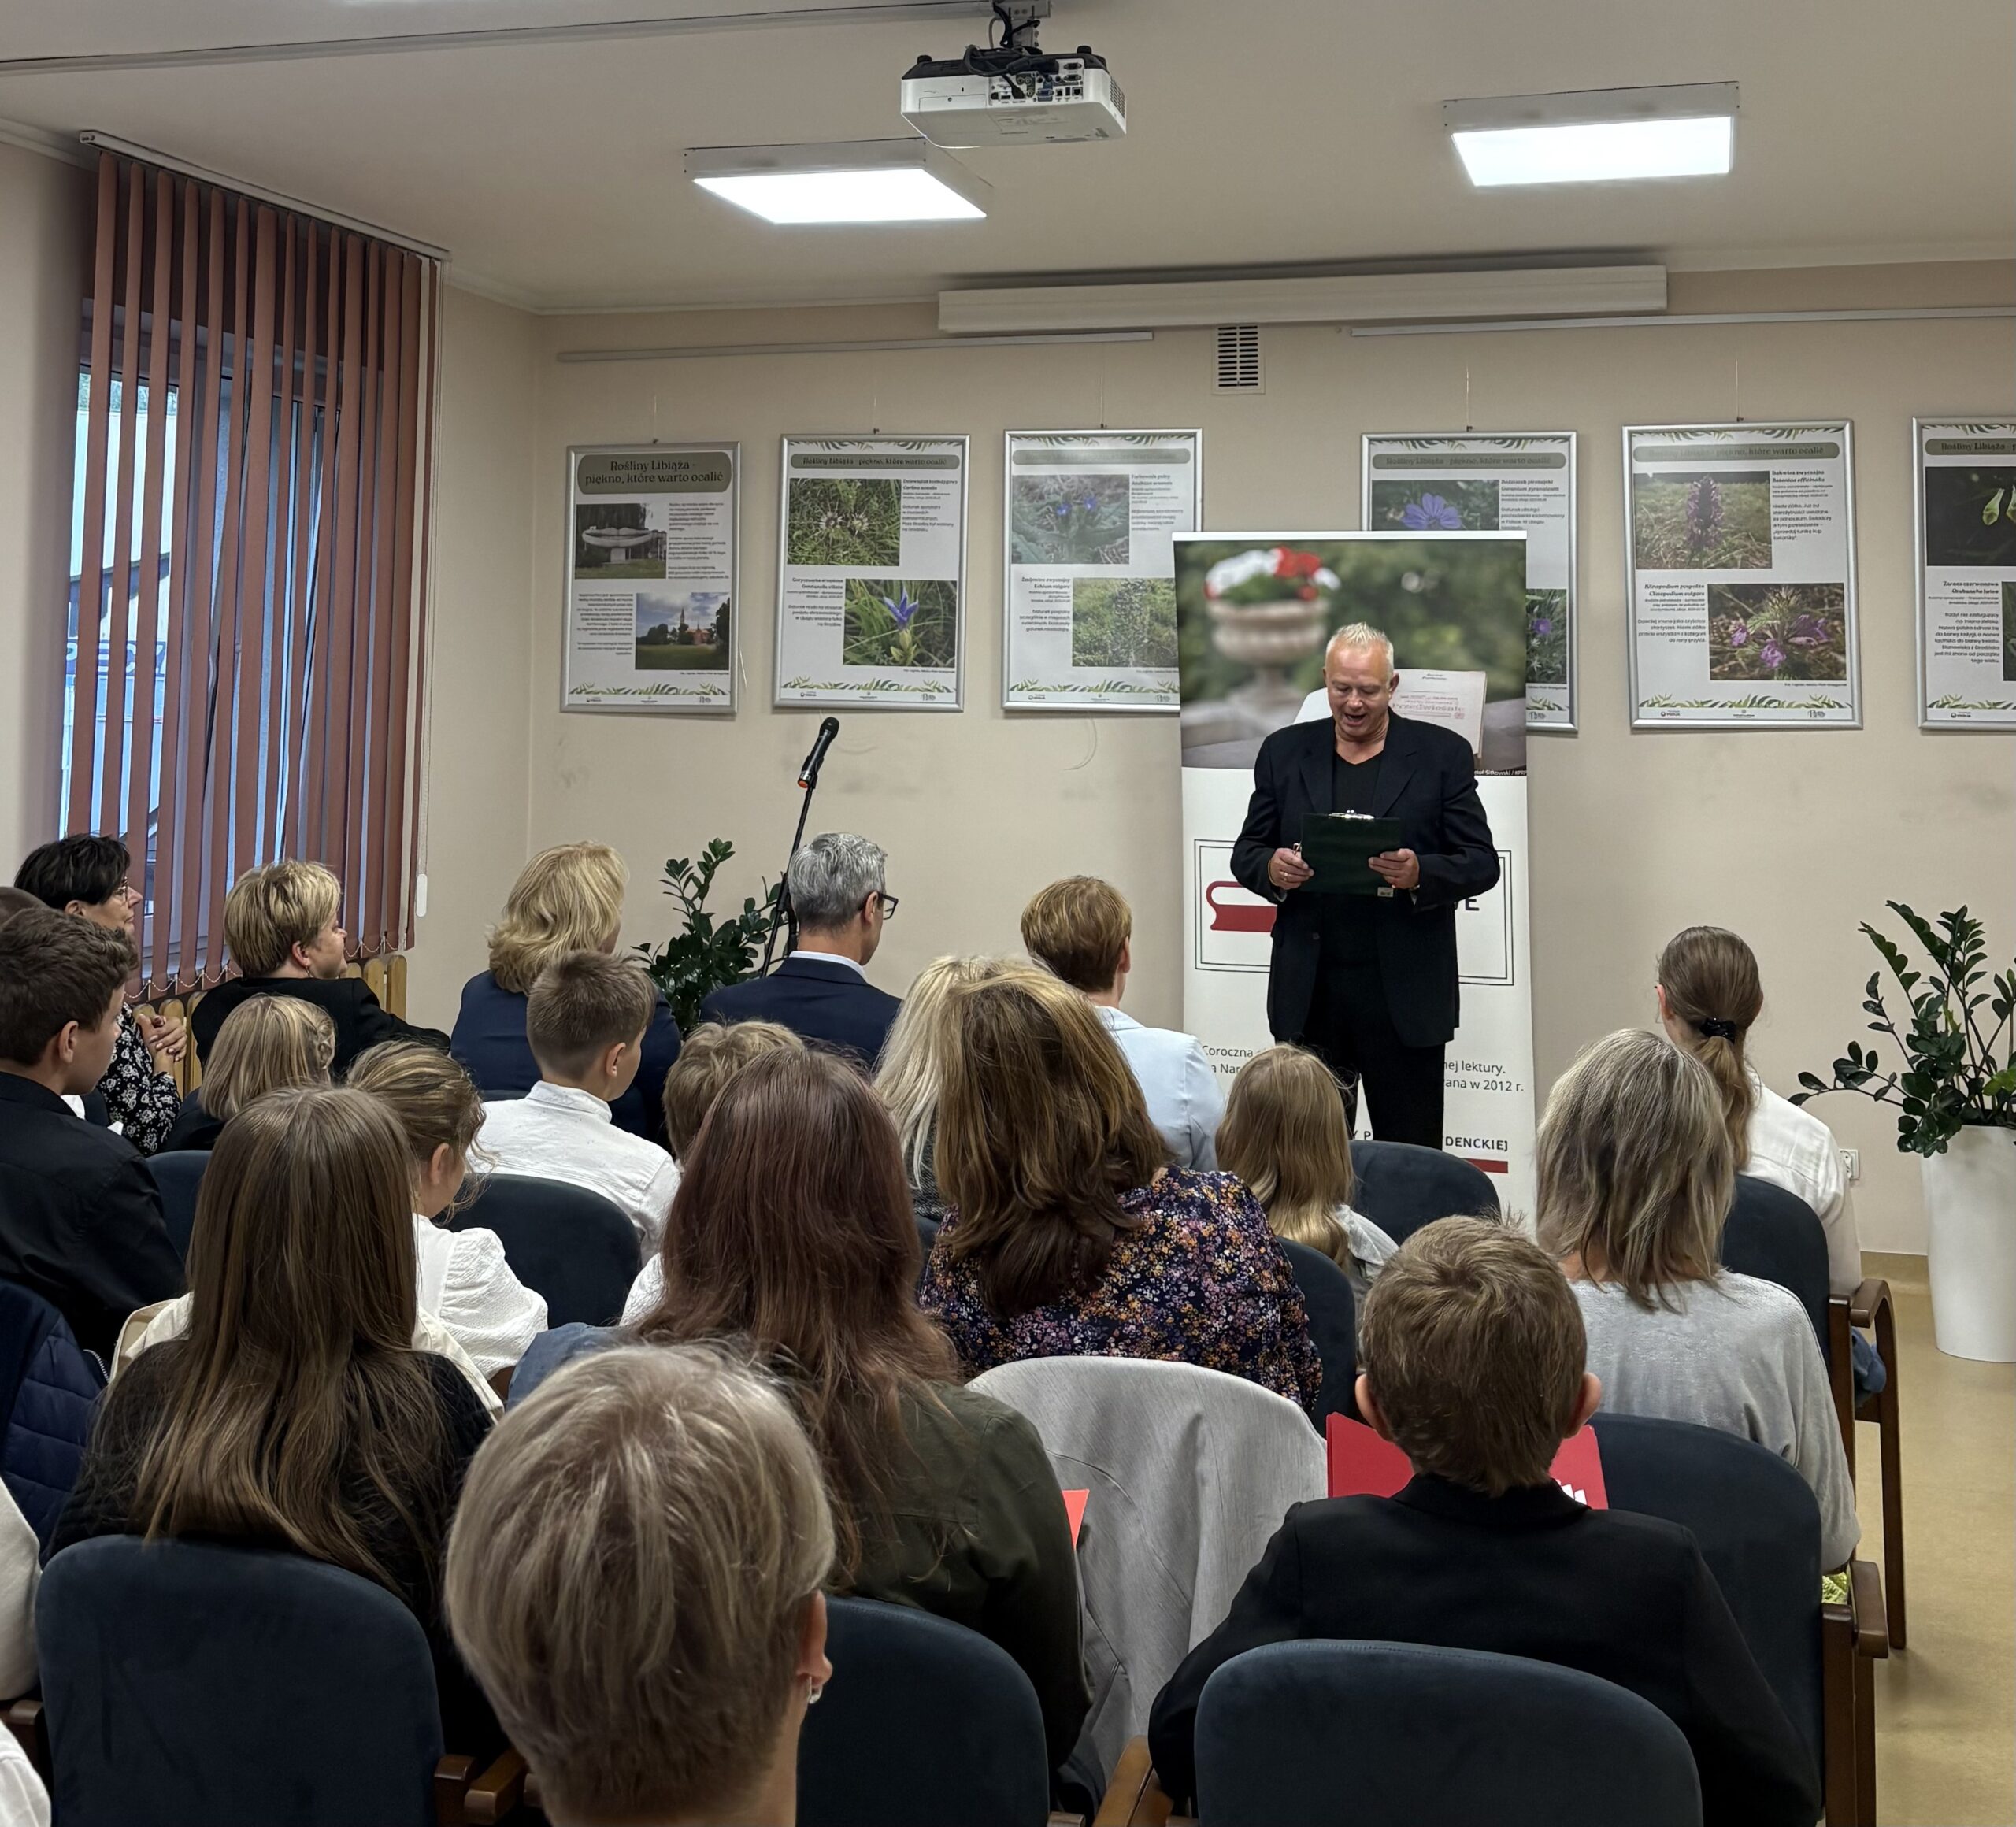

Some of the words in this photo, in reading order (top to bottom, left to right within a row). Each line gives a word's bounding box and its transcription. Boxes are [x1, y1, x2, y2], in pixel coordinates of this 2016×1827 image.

[610, 461, 650, 473] Rośliny
[651, 459, 690, 472] Libiąża
[585, 474, 624, 486] piękno,
[627, 473, 656, 484] które
[658, 473, 689, 483] warto
[691, 472, 723, 482] ocalić
[1462, 1059, 1506, 1077] lektury.
[1469, 1081, 1480, 1090] w
[1483, 1080, 1513, 1091] 2012
[1515, 1083, 1525, 1091] r.
[1445, 1136, 1508, 1152] DENCKIEJ
